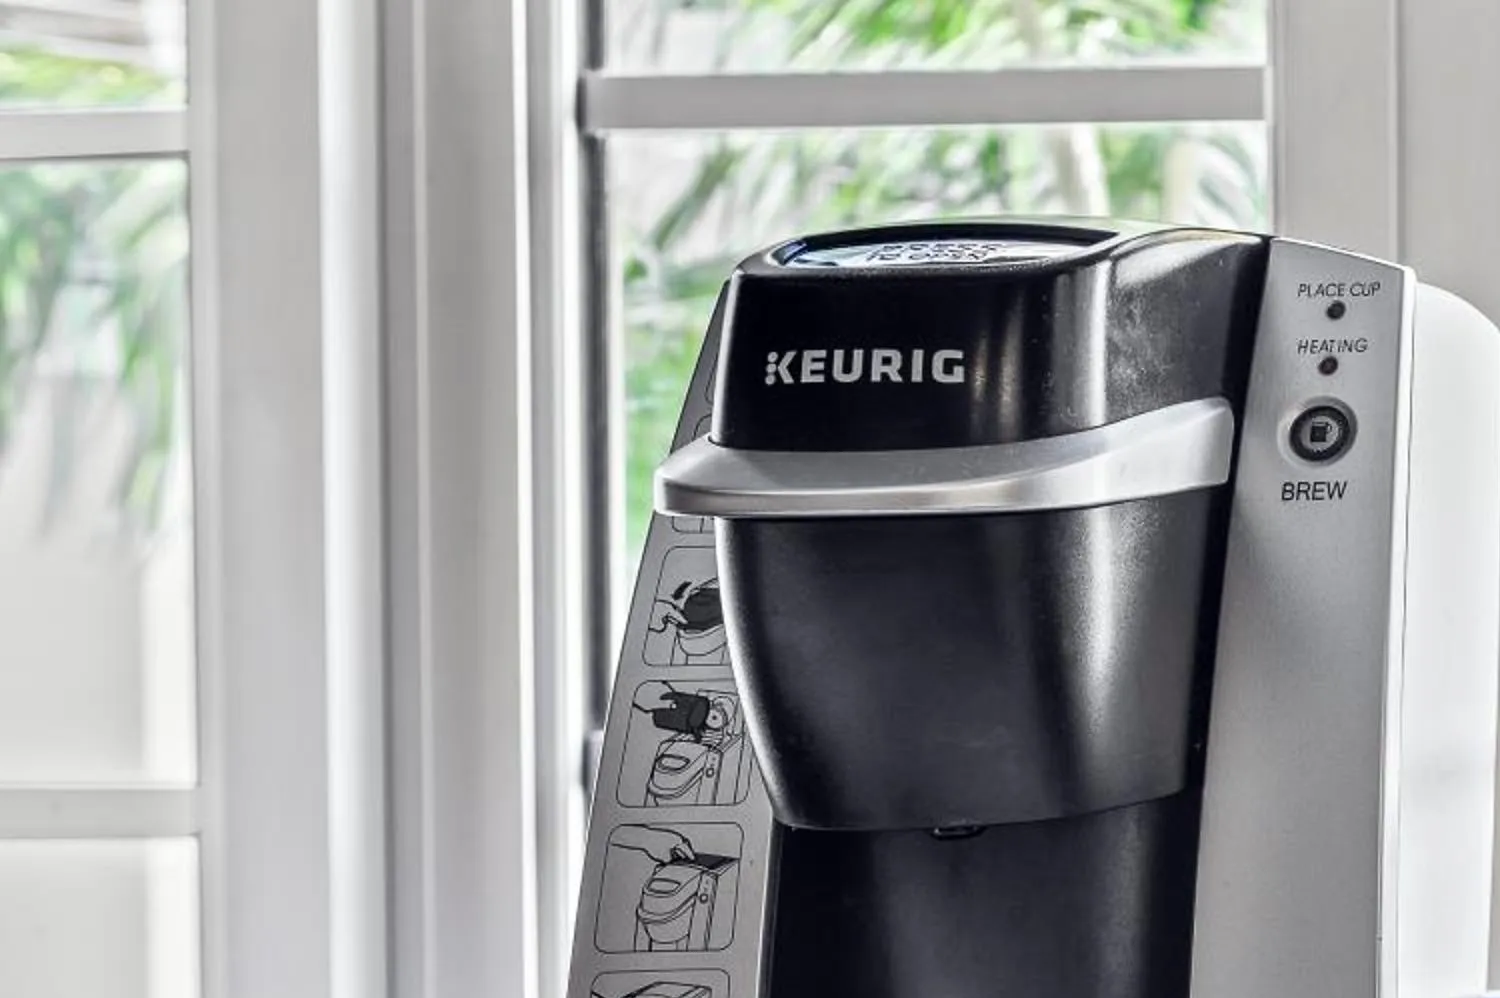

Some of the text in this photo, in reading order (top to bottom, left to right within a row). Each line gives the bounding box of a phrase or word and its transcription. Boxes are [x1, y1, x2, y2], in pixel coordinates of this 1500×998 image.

[1297, 281, 1381, 298] PLACE CUP
[1297, 338, 1369, 354] HEATING
[765, 348, 966, 386] KEURIG
[1281, 481, 1347, 501] BREW
